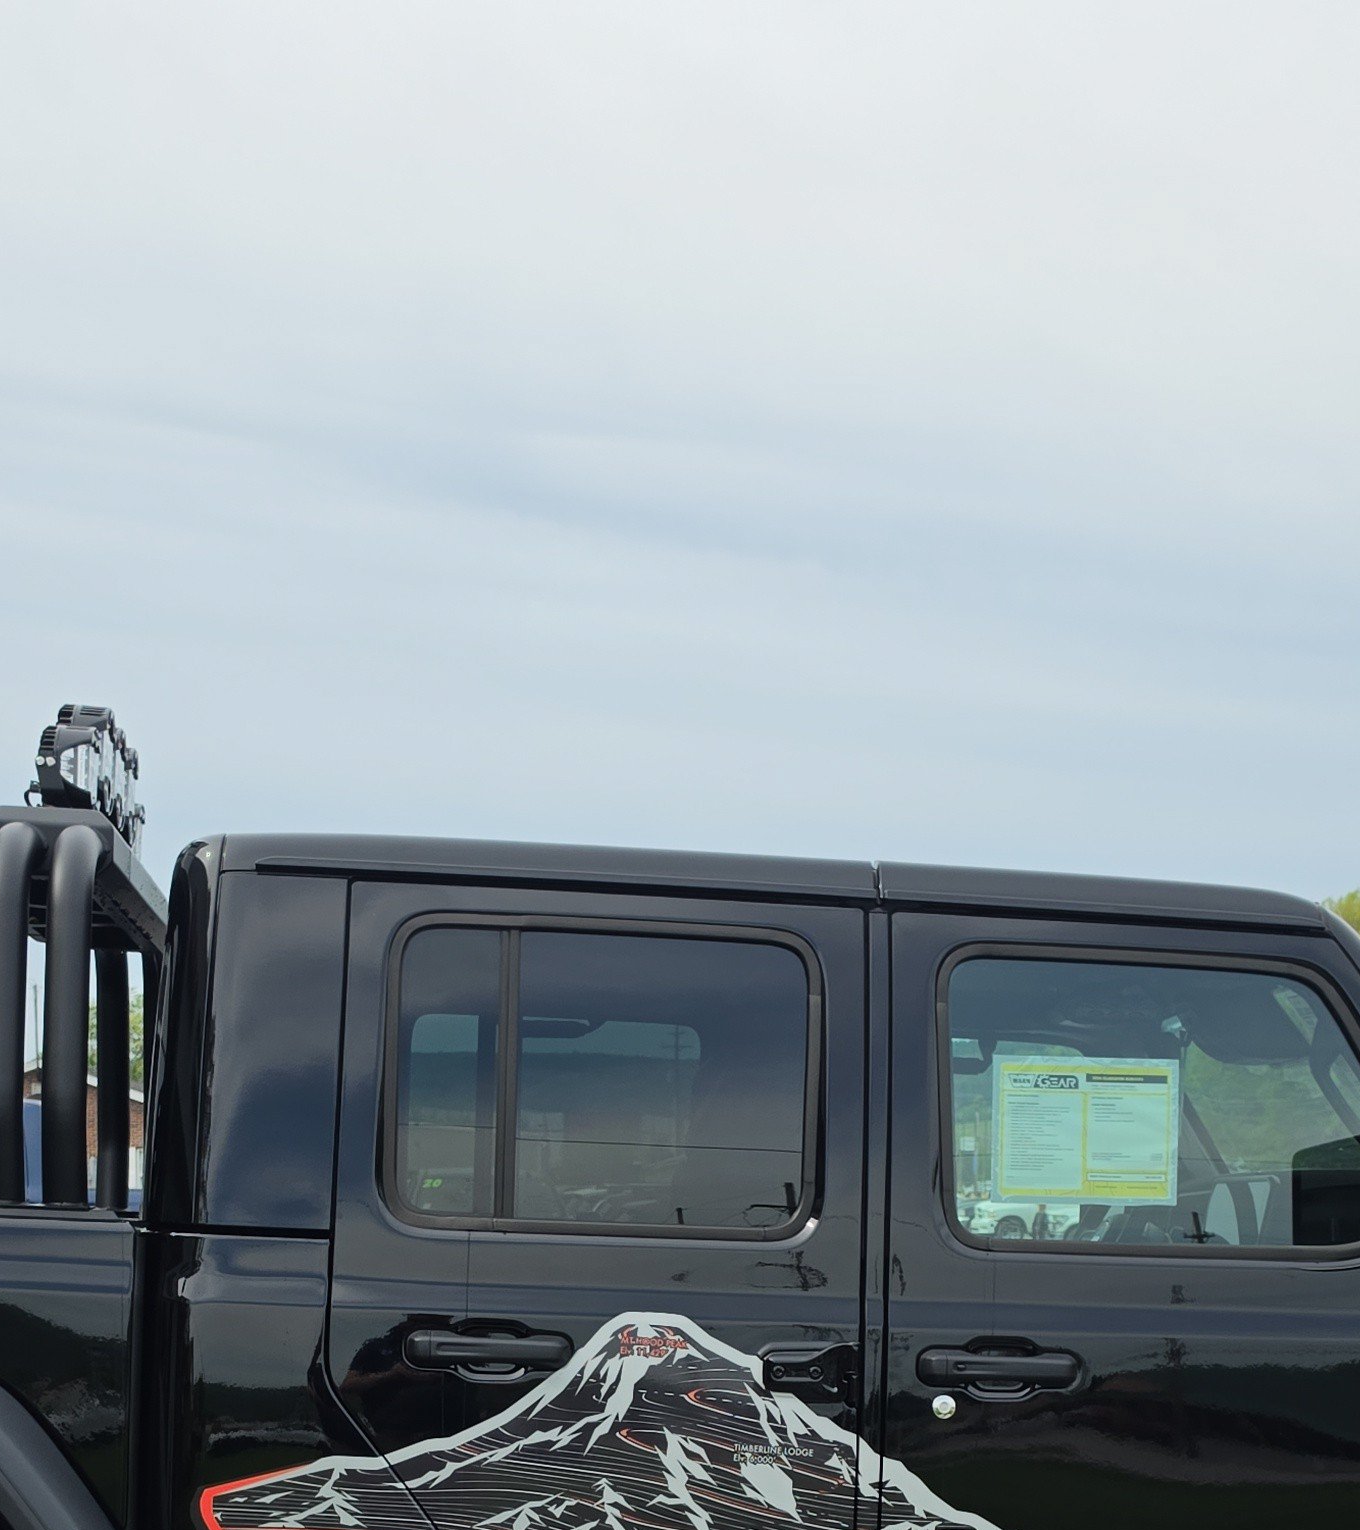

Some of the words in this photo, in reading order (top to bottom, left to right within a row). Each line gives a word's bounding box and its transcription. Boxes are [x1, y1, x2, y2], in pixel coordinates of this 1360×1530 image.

[1038, 1075, 1078, 1089] GEAR
[666, 1339, 689, 1349] PEAK
[734, 1443, 782, 1455] TIMBERLINE
[784, 1447, 814, 1457] LODGE
